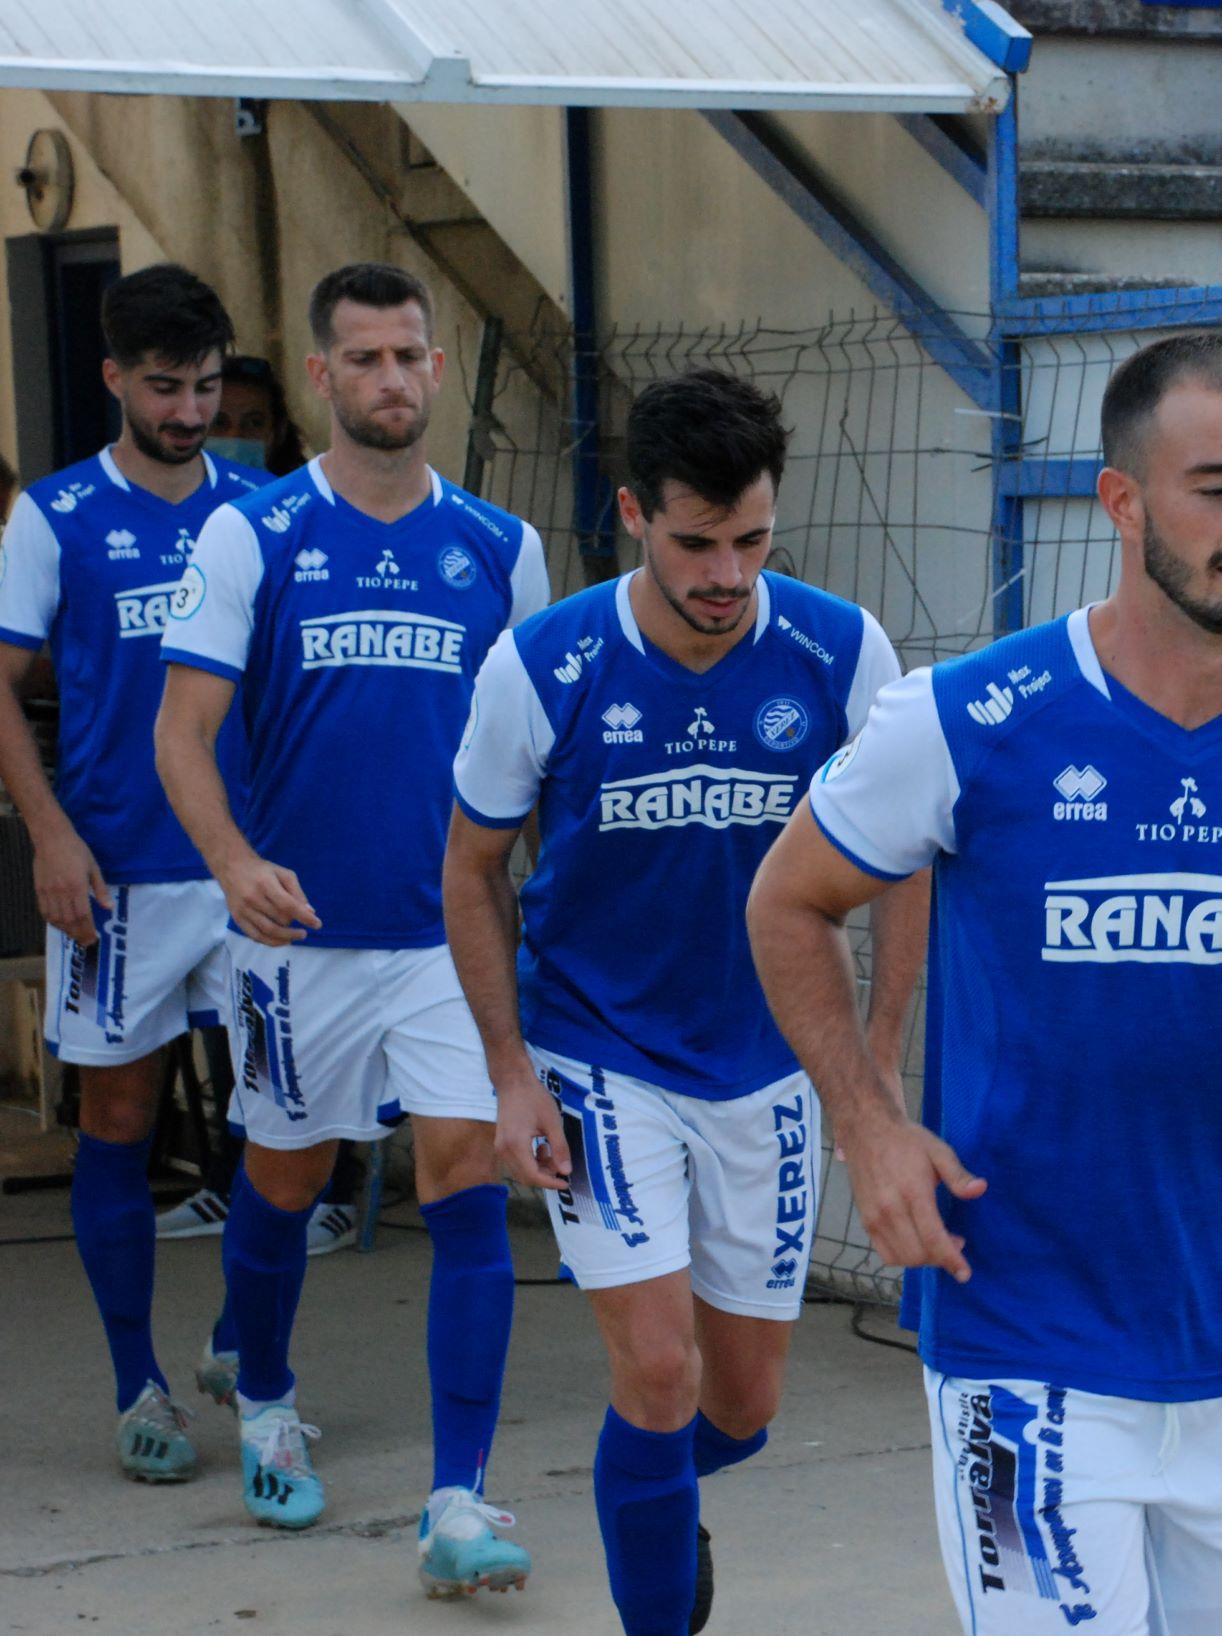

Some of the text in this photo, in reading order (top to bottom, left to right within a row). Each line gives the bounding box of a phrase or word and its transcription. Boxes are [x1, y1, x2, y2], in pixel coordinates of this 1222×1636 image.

[356, 576, 419, 592] TIO PEPE
[301, 623, 464, 668] RANABE
[790, 627, 835, 666] WINCOM
[1007, 664, 1032, 685] Max
[602, 728, 644, 745] errea
[664, 739, 738, 755] TIO PEPE
[599, 780, 795, 829] RANABE
[1053, 801, 1108, 821] errea
[1135, 823, 1176, 842] TIO
[772, 1094, 808, 1260] XEREZ
[970, 1393, 1006, 1595] Torralva
